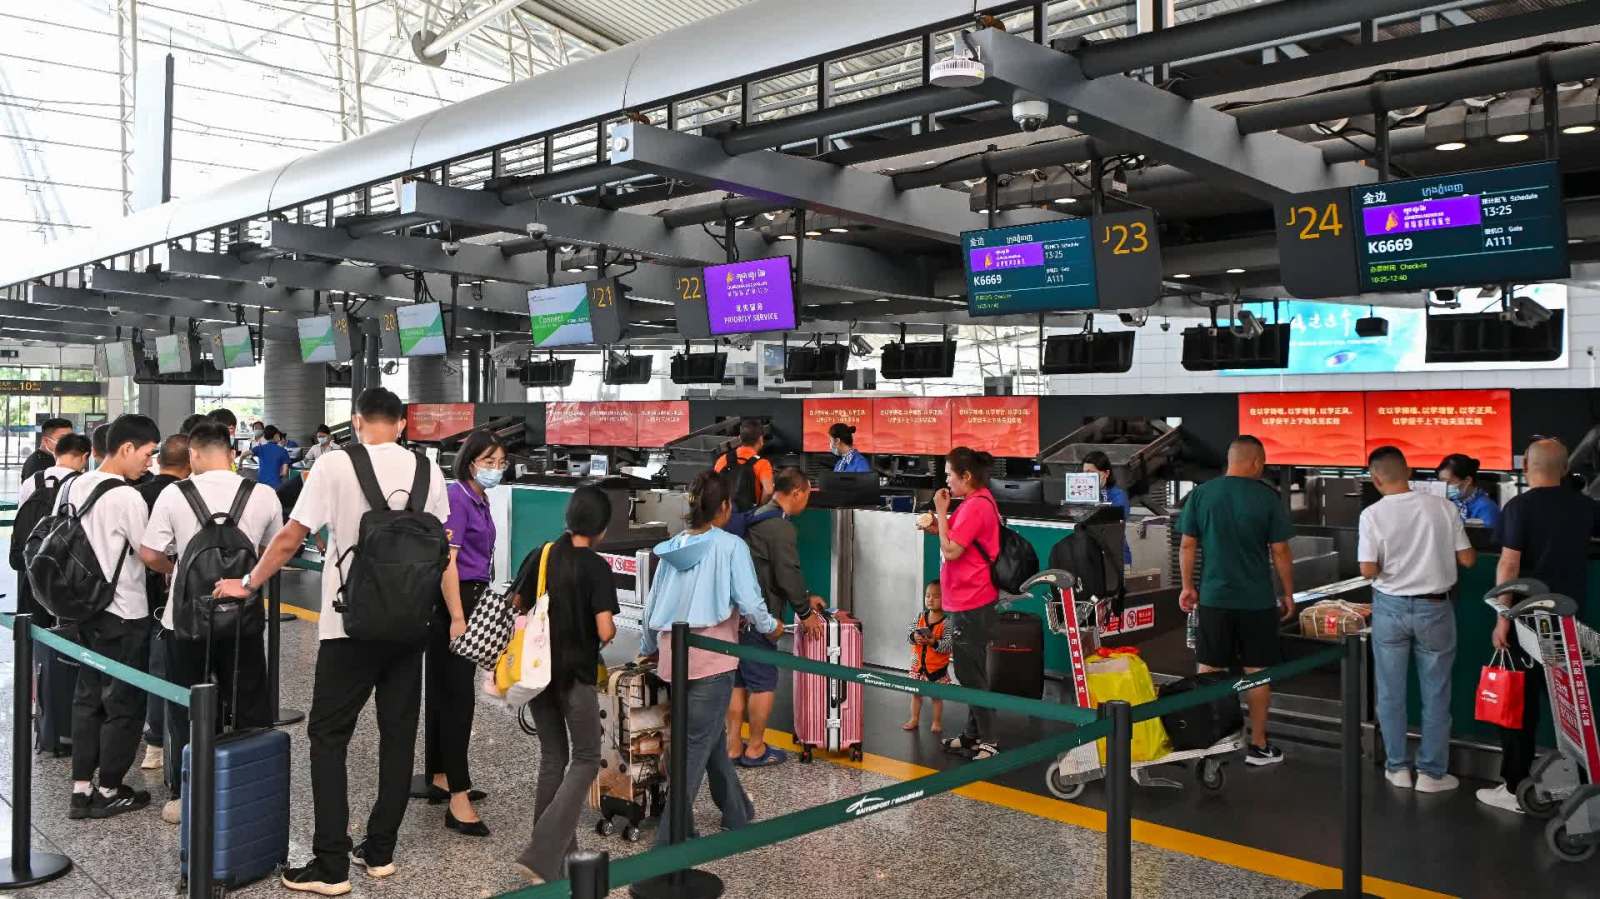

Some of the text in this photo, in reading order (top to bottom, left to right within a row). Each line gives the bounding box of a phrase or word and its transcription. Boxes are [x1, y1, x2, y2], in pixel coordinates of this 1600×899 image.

[1362, 190, 1387, 204] 金边
[1510, 193, 1538, 202] Schedule
[1483, 205, 1512, 216] 13:25
[1368, 238, 1413, 254] K6669
[1485, 236, 1512, 247] A111
[973, 274, 1002, 286] K6669
